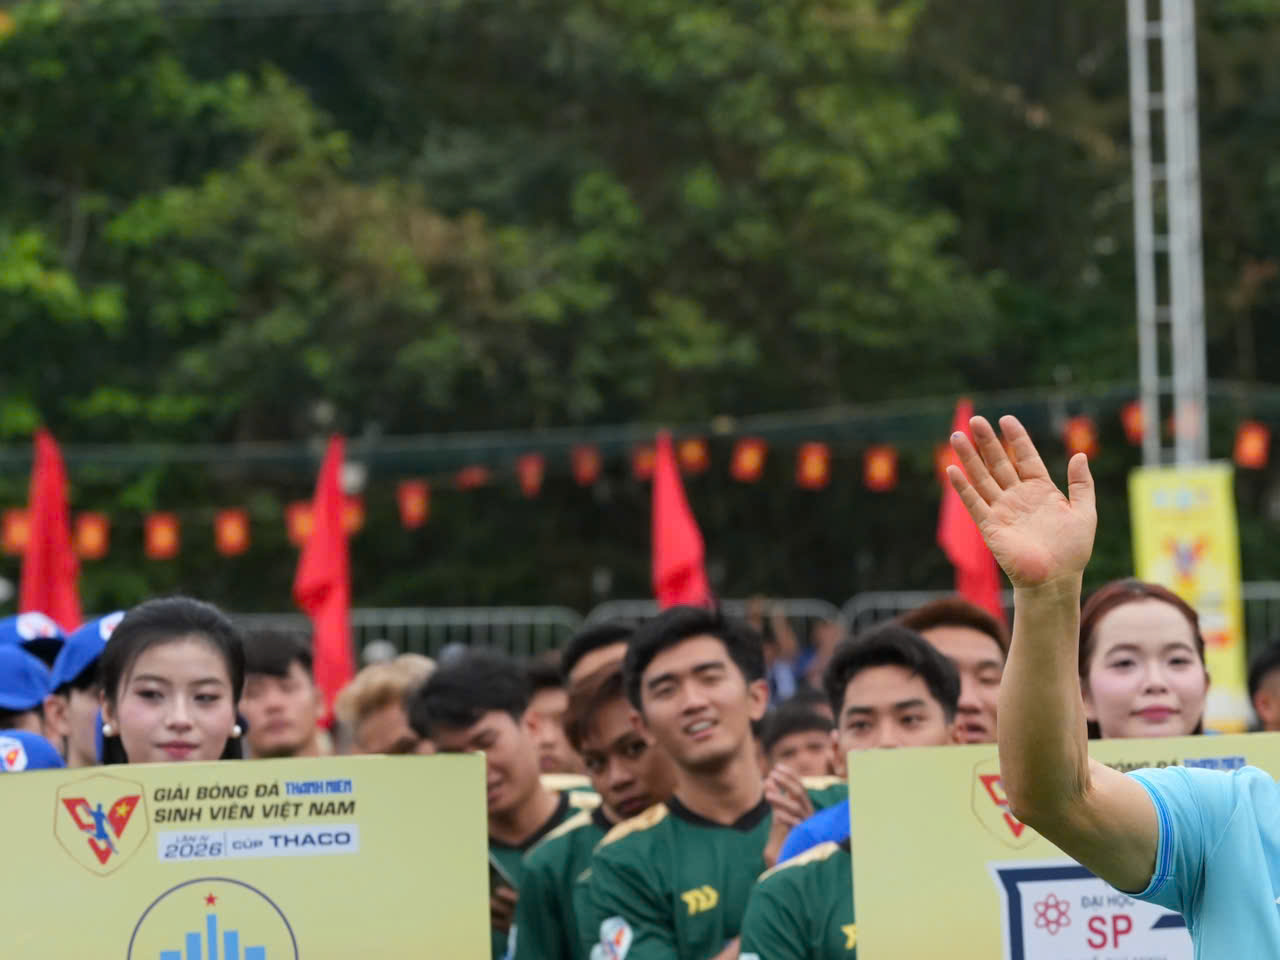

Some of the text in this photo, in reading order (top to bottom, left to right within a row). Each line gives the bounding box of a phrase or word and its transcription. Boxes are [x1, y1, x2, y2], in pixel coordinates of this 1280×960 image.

[196, 783, 248, 801] BÓNG
[254, 782, 280, 799] ĐÁ
[154, 801, 356, 823] SINH VIÊN VIỆT NAM
[269, 832, 351, 848] THACO
[165, 842, 223, 859] 2026
[1087, 914, 1133, 949] SP
